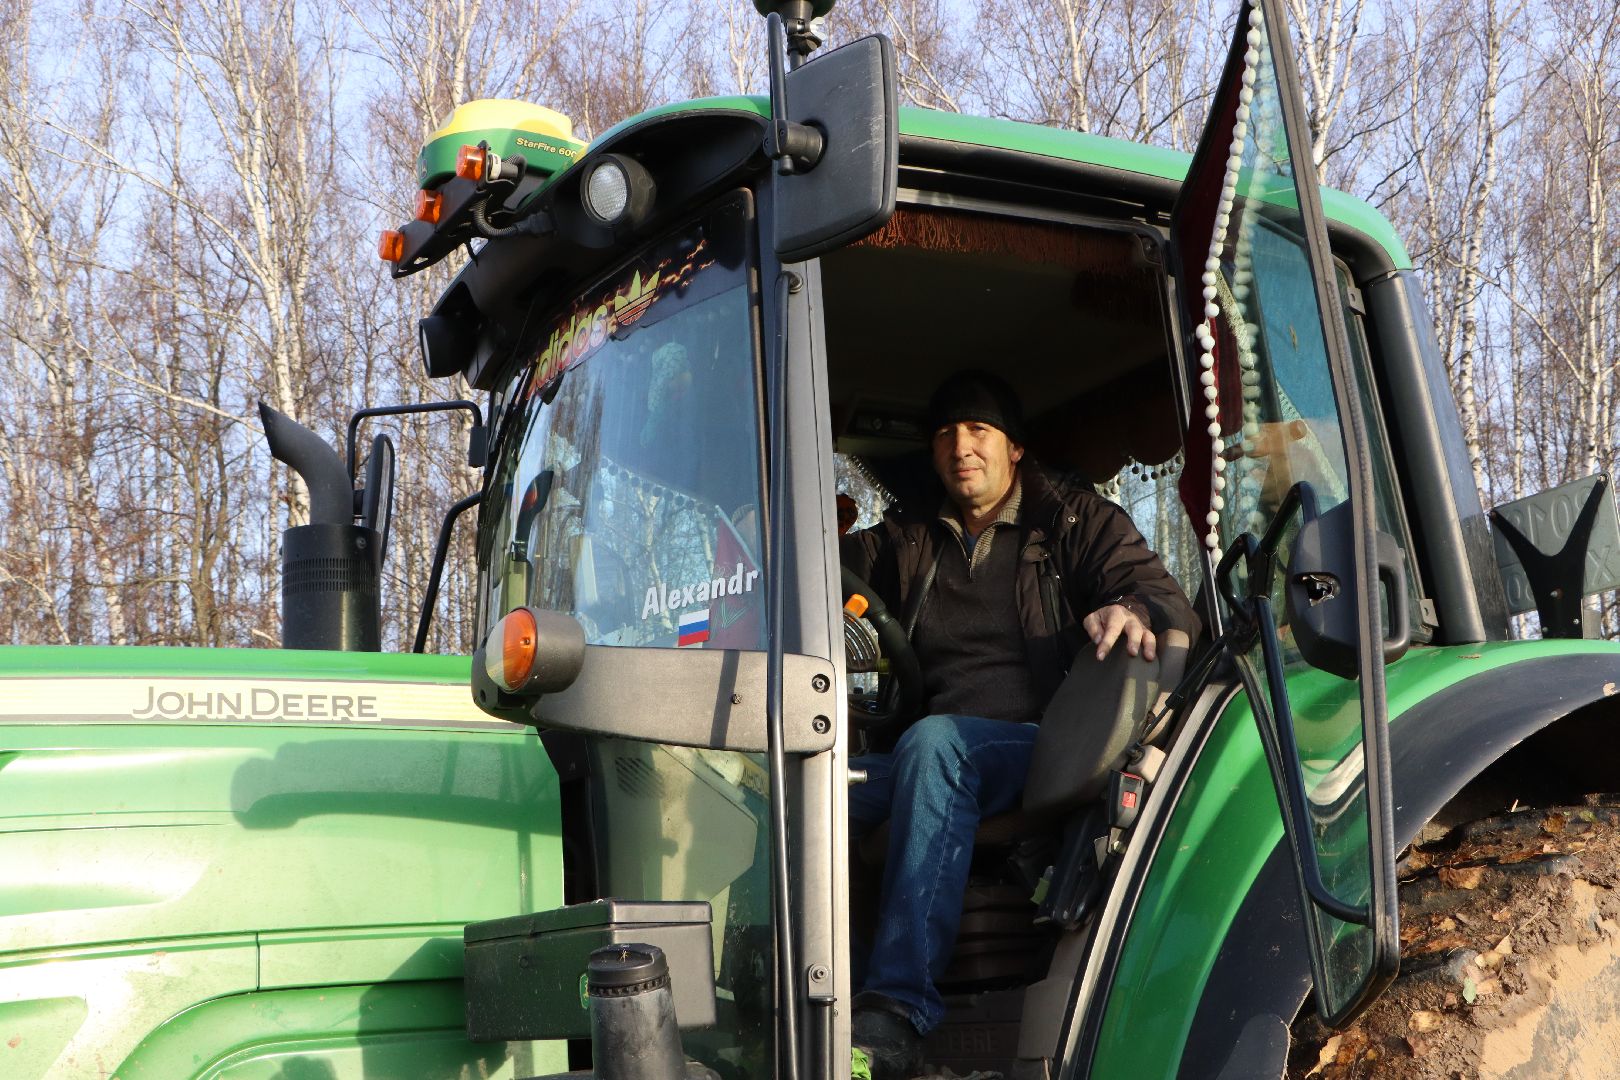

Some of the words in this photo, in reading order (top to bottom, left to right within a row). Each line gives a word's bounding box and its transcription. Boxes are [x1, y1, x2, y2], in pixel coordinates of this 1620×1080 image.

[516, 137, 557, 153] StarFire
[641, 562, 759, 620] Alexandr
[132, 686, 242, 715] JOHN
[251, 688, 378, 718] DEERE
